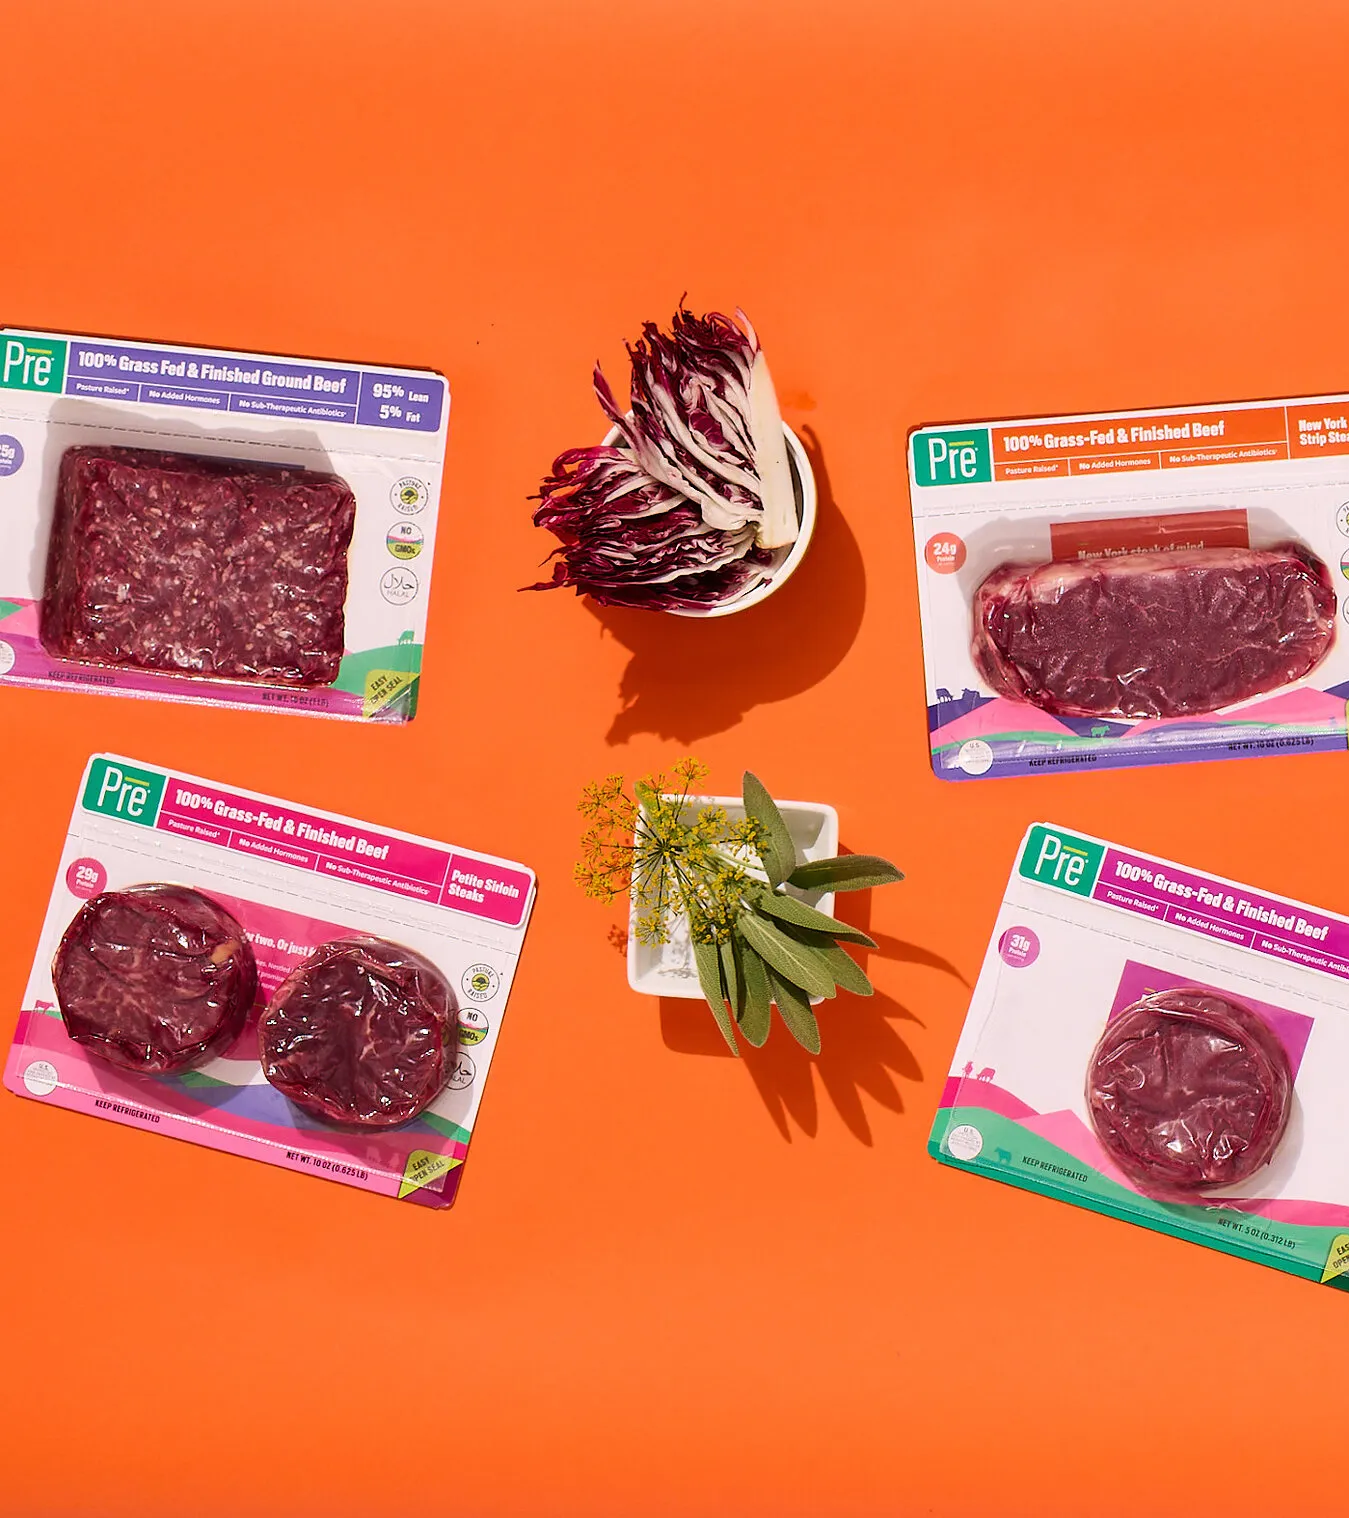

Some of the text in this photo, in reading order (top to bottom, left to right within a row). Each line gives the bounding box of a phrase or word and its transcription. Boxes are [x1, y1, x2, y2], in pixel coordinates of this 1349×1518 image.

[77, 350, 346, 394] 100% Grass Fed & Finished Ground Beef
[76, 382, 102, 392] Pasture
[372, 382, 429, 402] 95% Lean
[148, 390, 221, 405] No Added Hormones
[238, 399, 249, 408] No
[250, 401, 307, 414] Sub-Therapeutic
[378, 404, 421, 423] 5% Fat
[1298, 416, 1347, 432] New York
[1003, 420, 1225, 452] 100% Grass-Fed & Finished Beef
[1299, 432, 1326, 447] Strip
[1079, 457, 1151, 469] No Added Hormones
[1169, 454, 1180, 463] No
[1181, 450, 1238, 462] Sub-Therapeutic
[1005, 466, 1031, 474] Pasture
[400, 526, 411, 534] NO
[933, 541, 957, 556] 24g
[371, 675, 387, 691] EASY
[167, 818, 194, 832] Pasture
[173, 788, 390, 861] 100% Grass-Fed & Finished Beef
[238, 838, 308, 863] No Added Hormones
[75, 864, 99, 883] 29g
[325, 861, 336, 871] No
[336, 864, 392, 886] Sub-Therapeutic
[447, 883, 485, 903] Steaks
[451, 869, 520, 898] Petite Sirloin
[1106, 890, 1133, 905] Pasture
[1113, 860, 1329, 942] 100% Grass-Fed & Finished Beef
[1174, 912, 1244, 940] No Added Hormones
[254, 932, 277, 947] two.
[276, 938, 289, 951] Or
[286, 941, 310, 959] just
[1009, 933, 1032, 952] 31g
[1260, 939, 1273, 950] No
[1272, 943, 1328, 967] Sub-Therapeutic
[466, 1011, 478, 1022] NO
[94, 1099, 160, 1123] KEEP REFRIGERATED
[285, 1151, 368, 1181] NET WT. 10 OZ (0.625 LB)
[412, 1157, 431, 1170] EASY
[427, 1161, 444, 1174] SEAL
[1022, 1155, 1088, 1182] KEEP REFRIGERATED
[1217, 1217, 1296, 1250] NET WT. 5 OZ (0.312 LB)
[1332, 1255, 1349, 1268] OPEN
